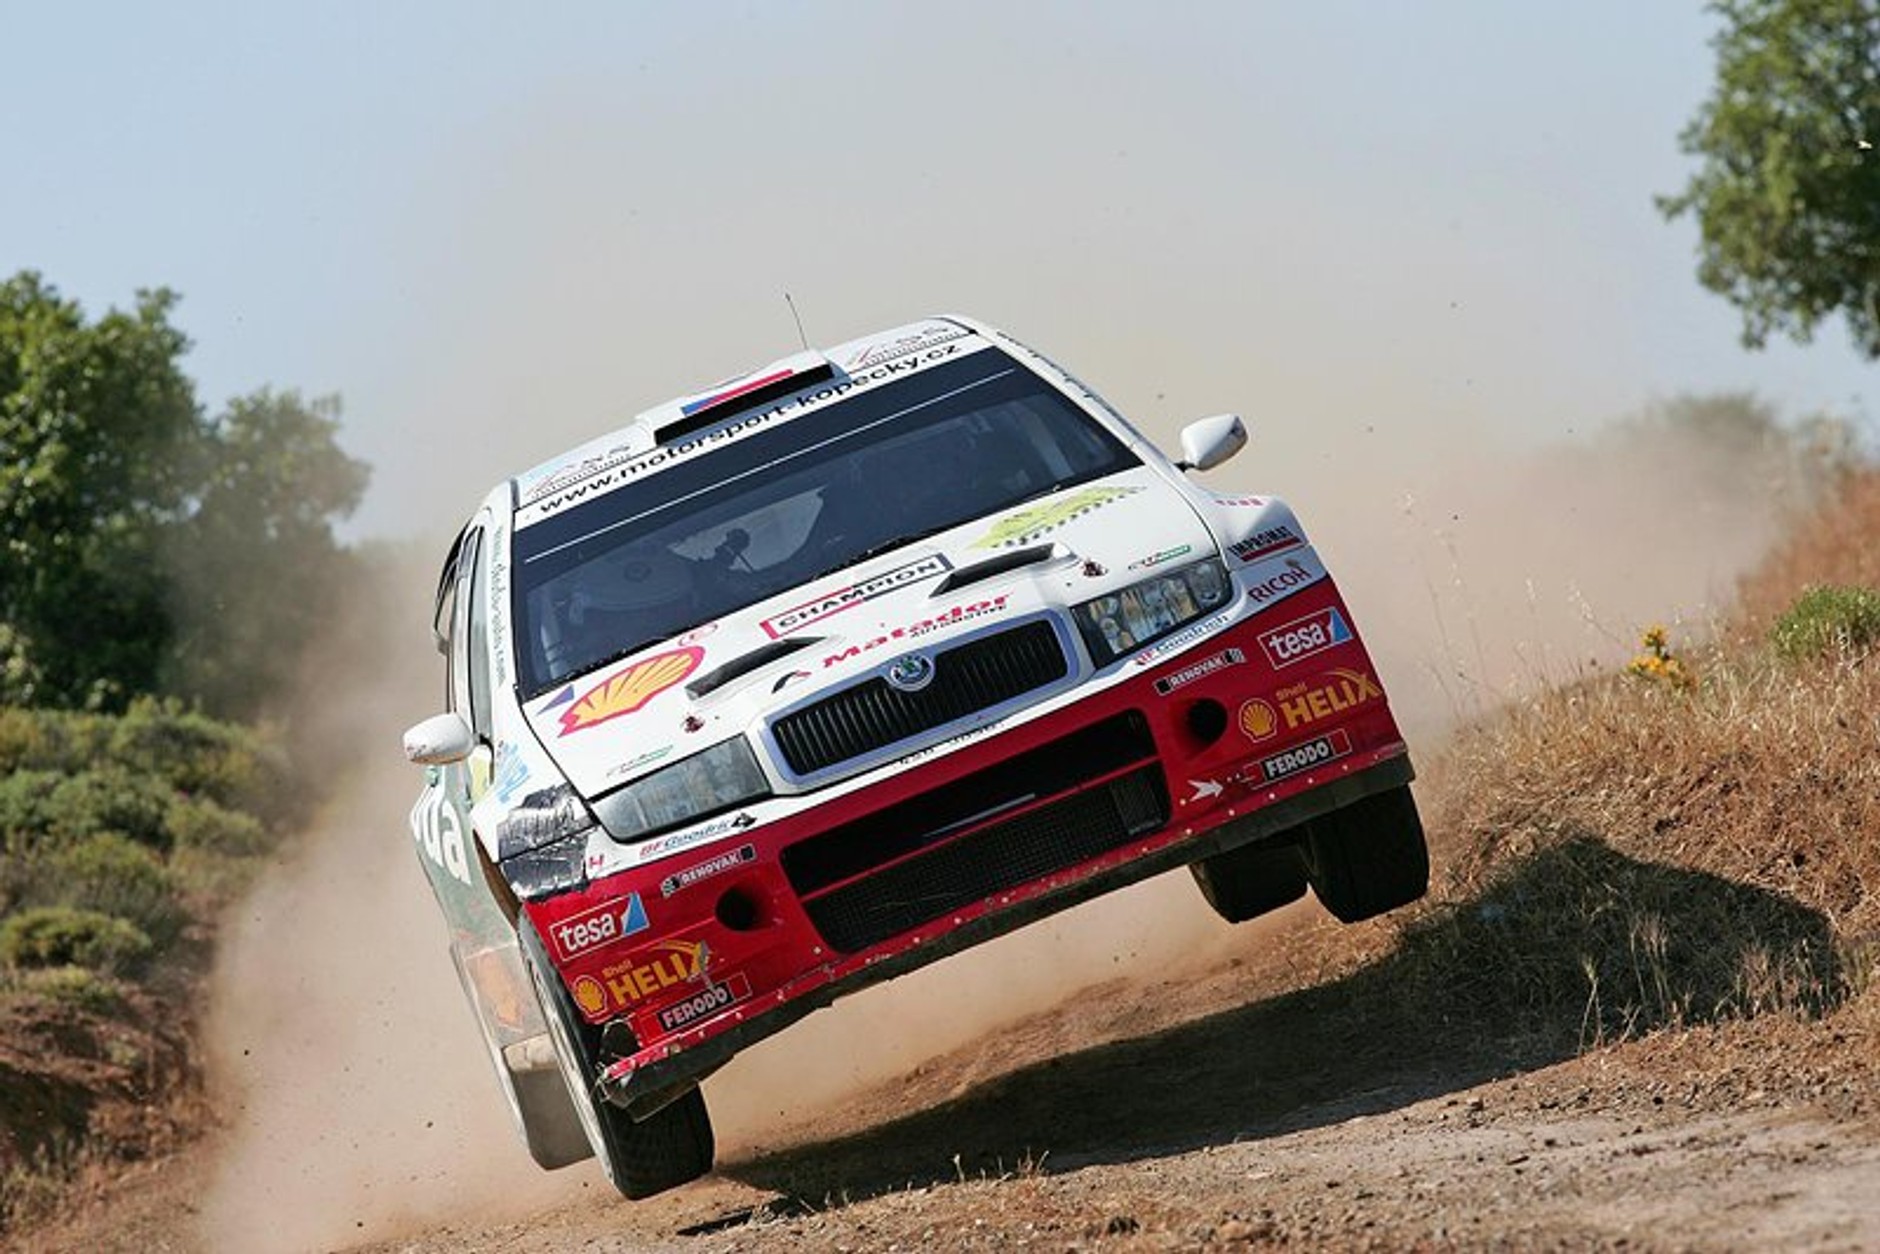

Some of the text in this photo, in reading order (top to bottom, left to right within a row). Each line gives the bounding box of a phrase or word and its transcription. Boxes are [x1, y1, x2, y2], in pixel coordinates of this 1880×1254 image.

[540, 344, 962, 513] www.motorsport-kopecky.cz
[779, 562, 938, 628] CHAMPION
[1248, 566, 1312, 602] RICOH
[823, 592, 1014, 667] Matador
[1269, 622, 1326, 659] tesa
[1280, 672, 1383, 729] HELIX
[1265, 741, 1330, 778] FERODO
[682, 852, 740, 885] RENOVAK
[559, 912, 617, 952] tesa
[607, 939, 711, 1006] HELIX
[662, 983, 729, 1028] FERODO
